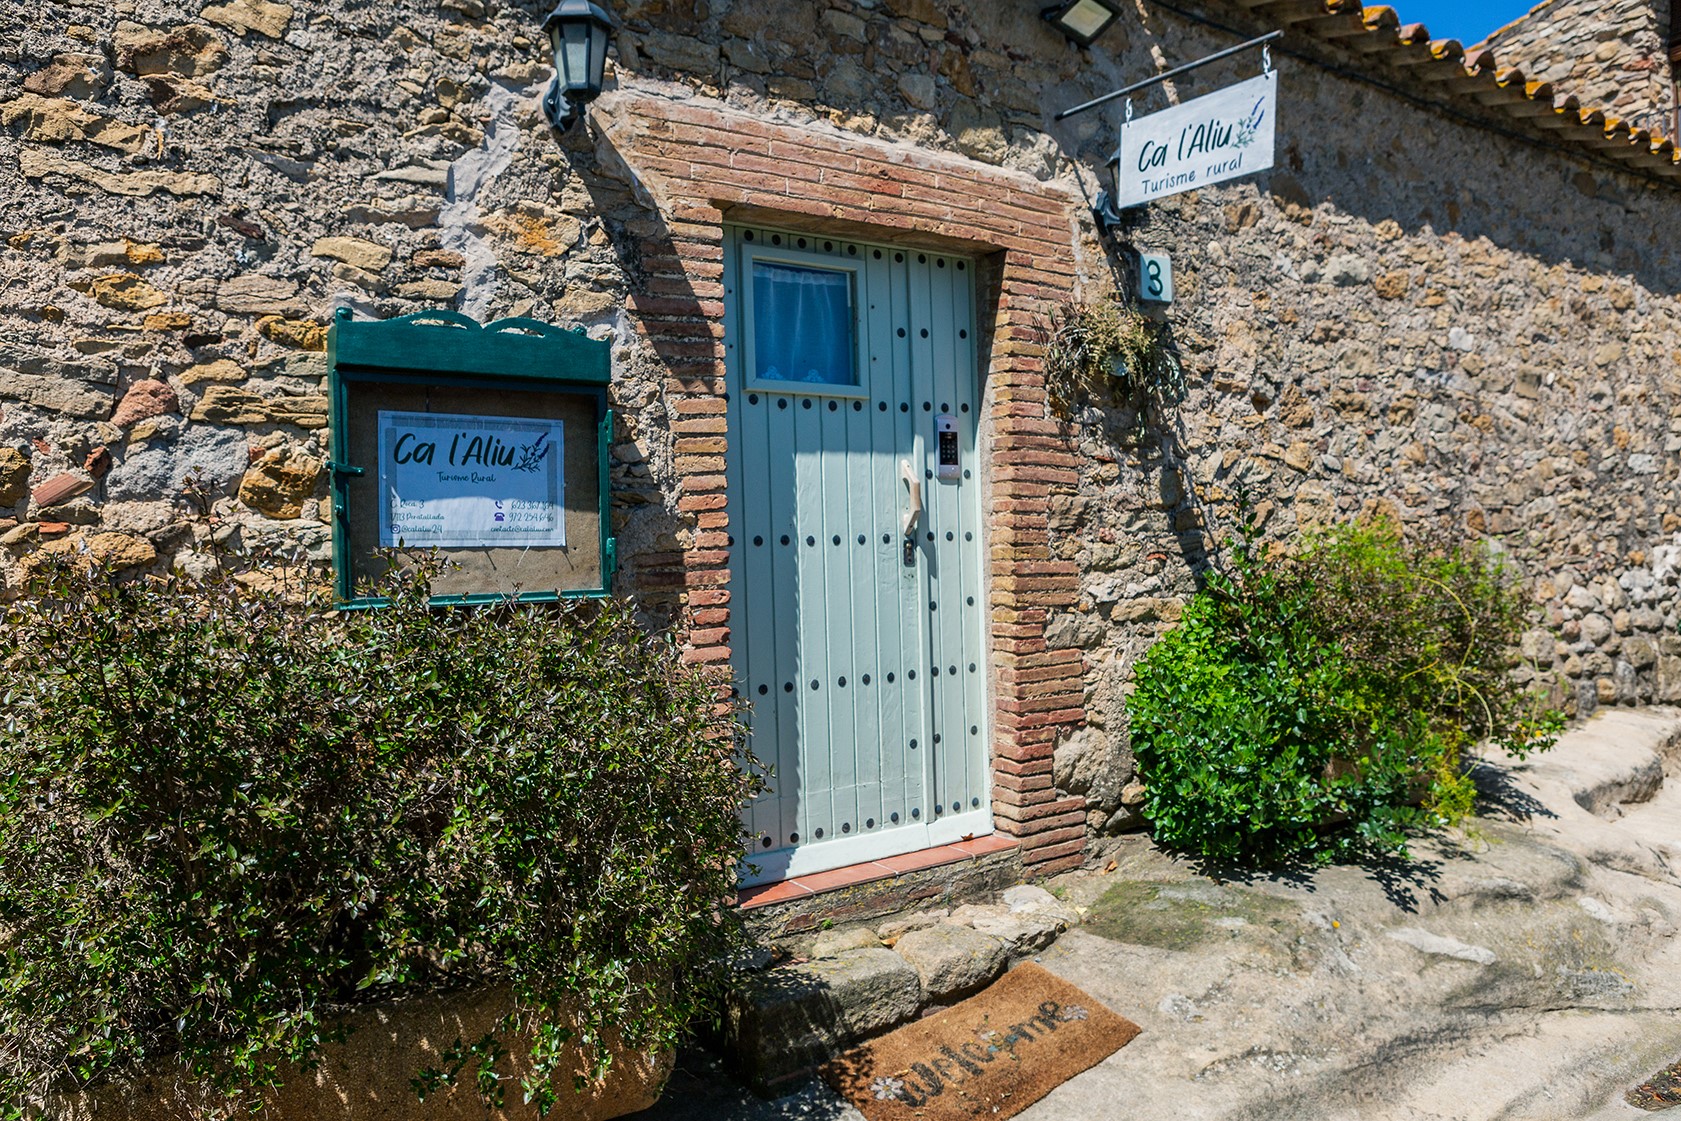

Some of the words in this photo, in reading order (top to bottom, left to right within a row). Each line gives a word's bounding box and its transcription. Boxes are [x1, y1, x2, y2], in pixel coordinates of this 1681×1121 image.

[1138, 140, 1169, 172] Ca
[1177, 119, 1233, 161] l'Aliu
[1142, 170, 1196, 194] Turisme
[1206, 152, 1243, 177] rural
[1147, 259, 1164, 297] 3
[393, 432, 436, 466] Ca
[449, 432, 516, 467] l'Aliu
[436, 471, 470, 483] Turisme
[471, 471, 497, 484] Rural
[419, 499, 425, 509] 3
[508, 512, 522, 522] 972
